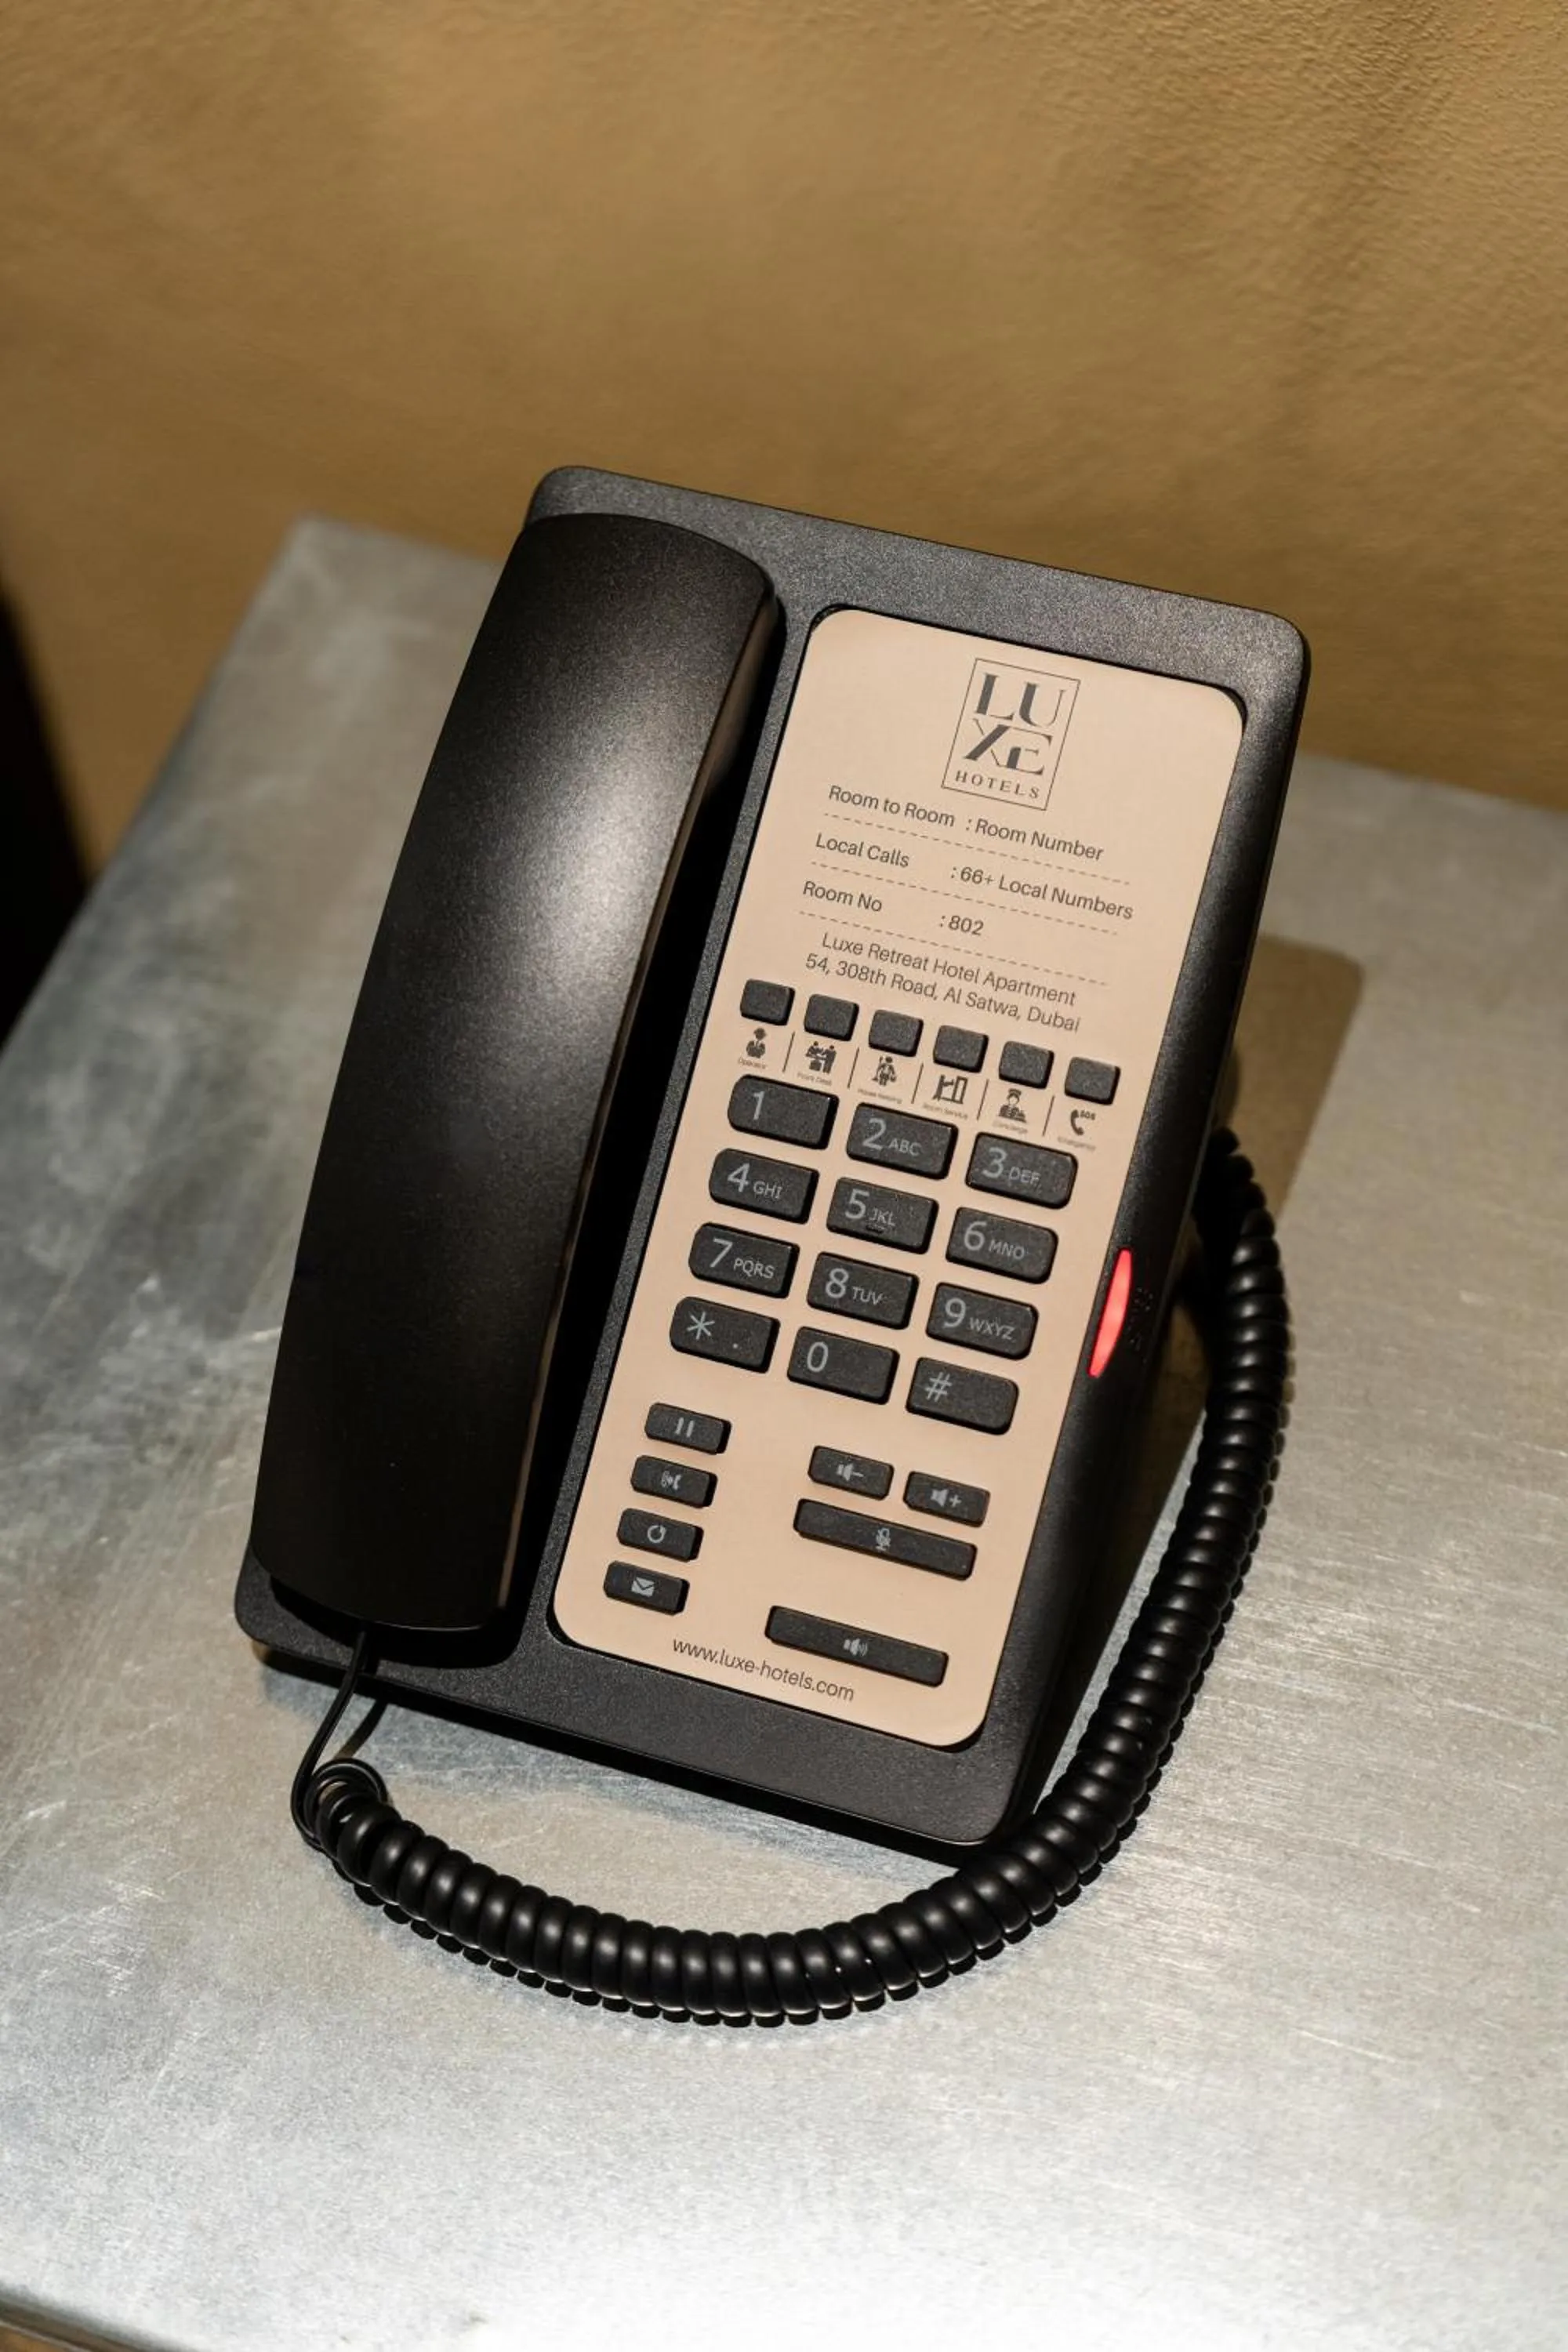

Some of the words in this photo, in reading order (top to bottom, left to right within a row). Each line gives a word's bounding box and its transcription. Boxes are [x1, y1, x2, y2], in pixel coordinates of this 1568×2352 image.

[955, 771, 1040, 799] HOTELS
[828, 786, 879, 811] Room
[884, 798, 899, 815] to
[905, 803, 956, 828] Room
[975, 820, 1027, 843] Room
[1032, 833, 1103, 861] Number
[816, 833, 863, 857] Local
[867, 845, 909, 868] Calls
[960, 866, 994, 886] 66+
[1000, 876, 1047, 899] Local
[1051, 887, 1134, 920] Numbers
[803, 881, 853, 906] Room
[858, 893, 882, 912] No
[949, 916, 984, 936] 802
[822, 934, 862, 956] Luxe
[868, 945, 929, 970] Retreat
[934, 960, 979, 985] Hotel
[983, 972, 1076, 1006] Apartment
[806, 955, 829, 975] 54,
[836, 961, 886, 985] 308th
[891, 975, 938, 1000] Road,
[943, 986, 961, 1004] Al
[967, 991, 1020, 1019] Satwa,
[1027, 1006, 1081, 1033] Dubai
[753, 1091, 765, 1120] 1
[862, 1118, 886, 1151] 2
[887, 1140, 922, 1157] ABC
[727, 1163, 749, 1192] 4
[753, 1181, 782, 1200] GHI
[982, 1147, 1006, 1178] 3
[1007, 1166, 1040, 1185] DEF
[845, 1189, 869, 1220] 5
[869, 1207, 896, 1227] JKL
[710, 1238, 732, 1268] 7
[733, 1257, 774, 1279] PQRS
[963, 1221, 987, 1250] 6
[989, 1239, 1025, 1260] MNO
[826, 1268, 849, 1299] 8
[851, 1286, 884, 1305] TUV
[943, 1297, 967, 1327] 9
[968, 1317, 1014, 1341] WXYZ
[807, 1341, 829, 1372] 0
[673, 1638, 854, 1701] www.luxe-hotels.com
